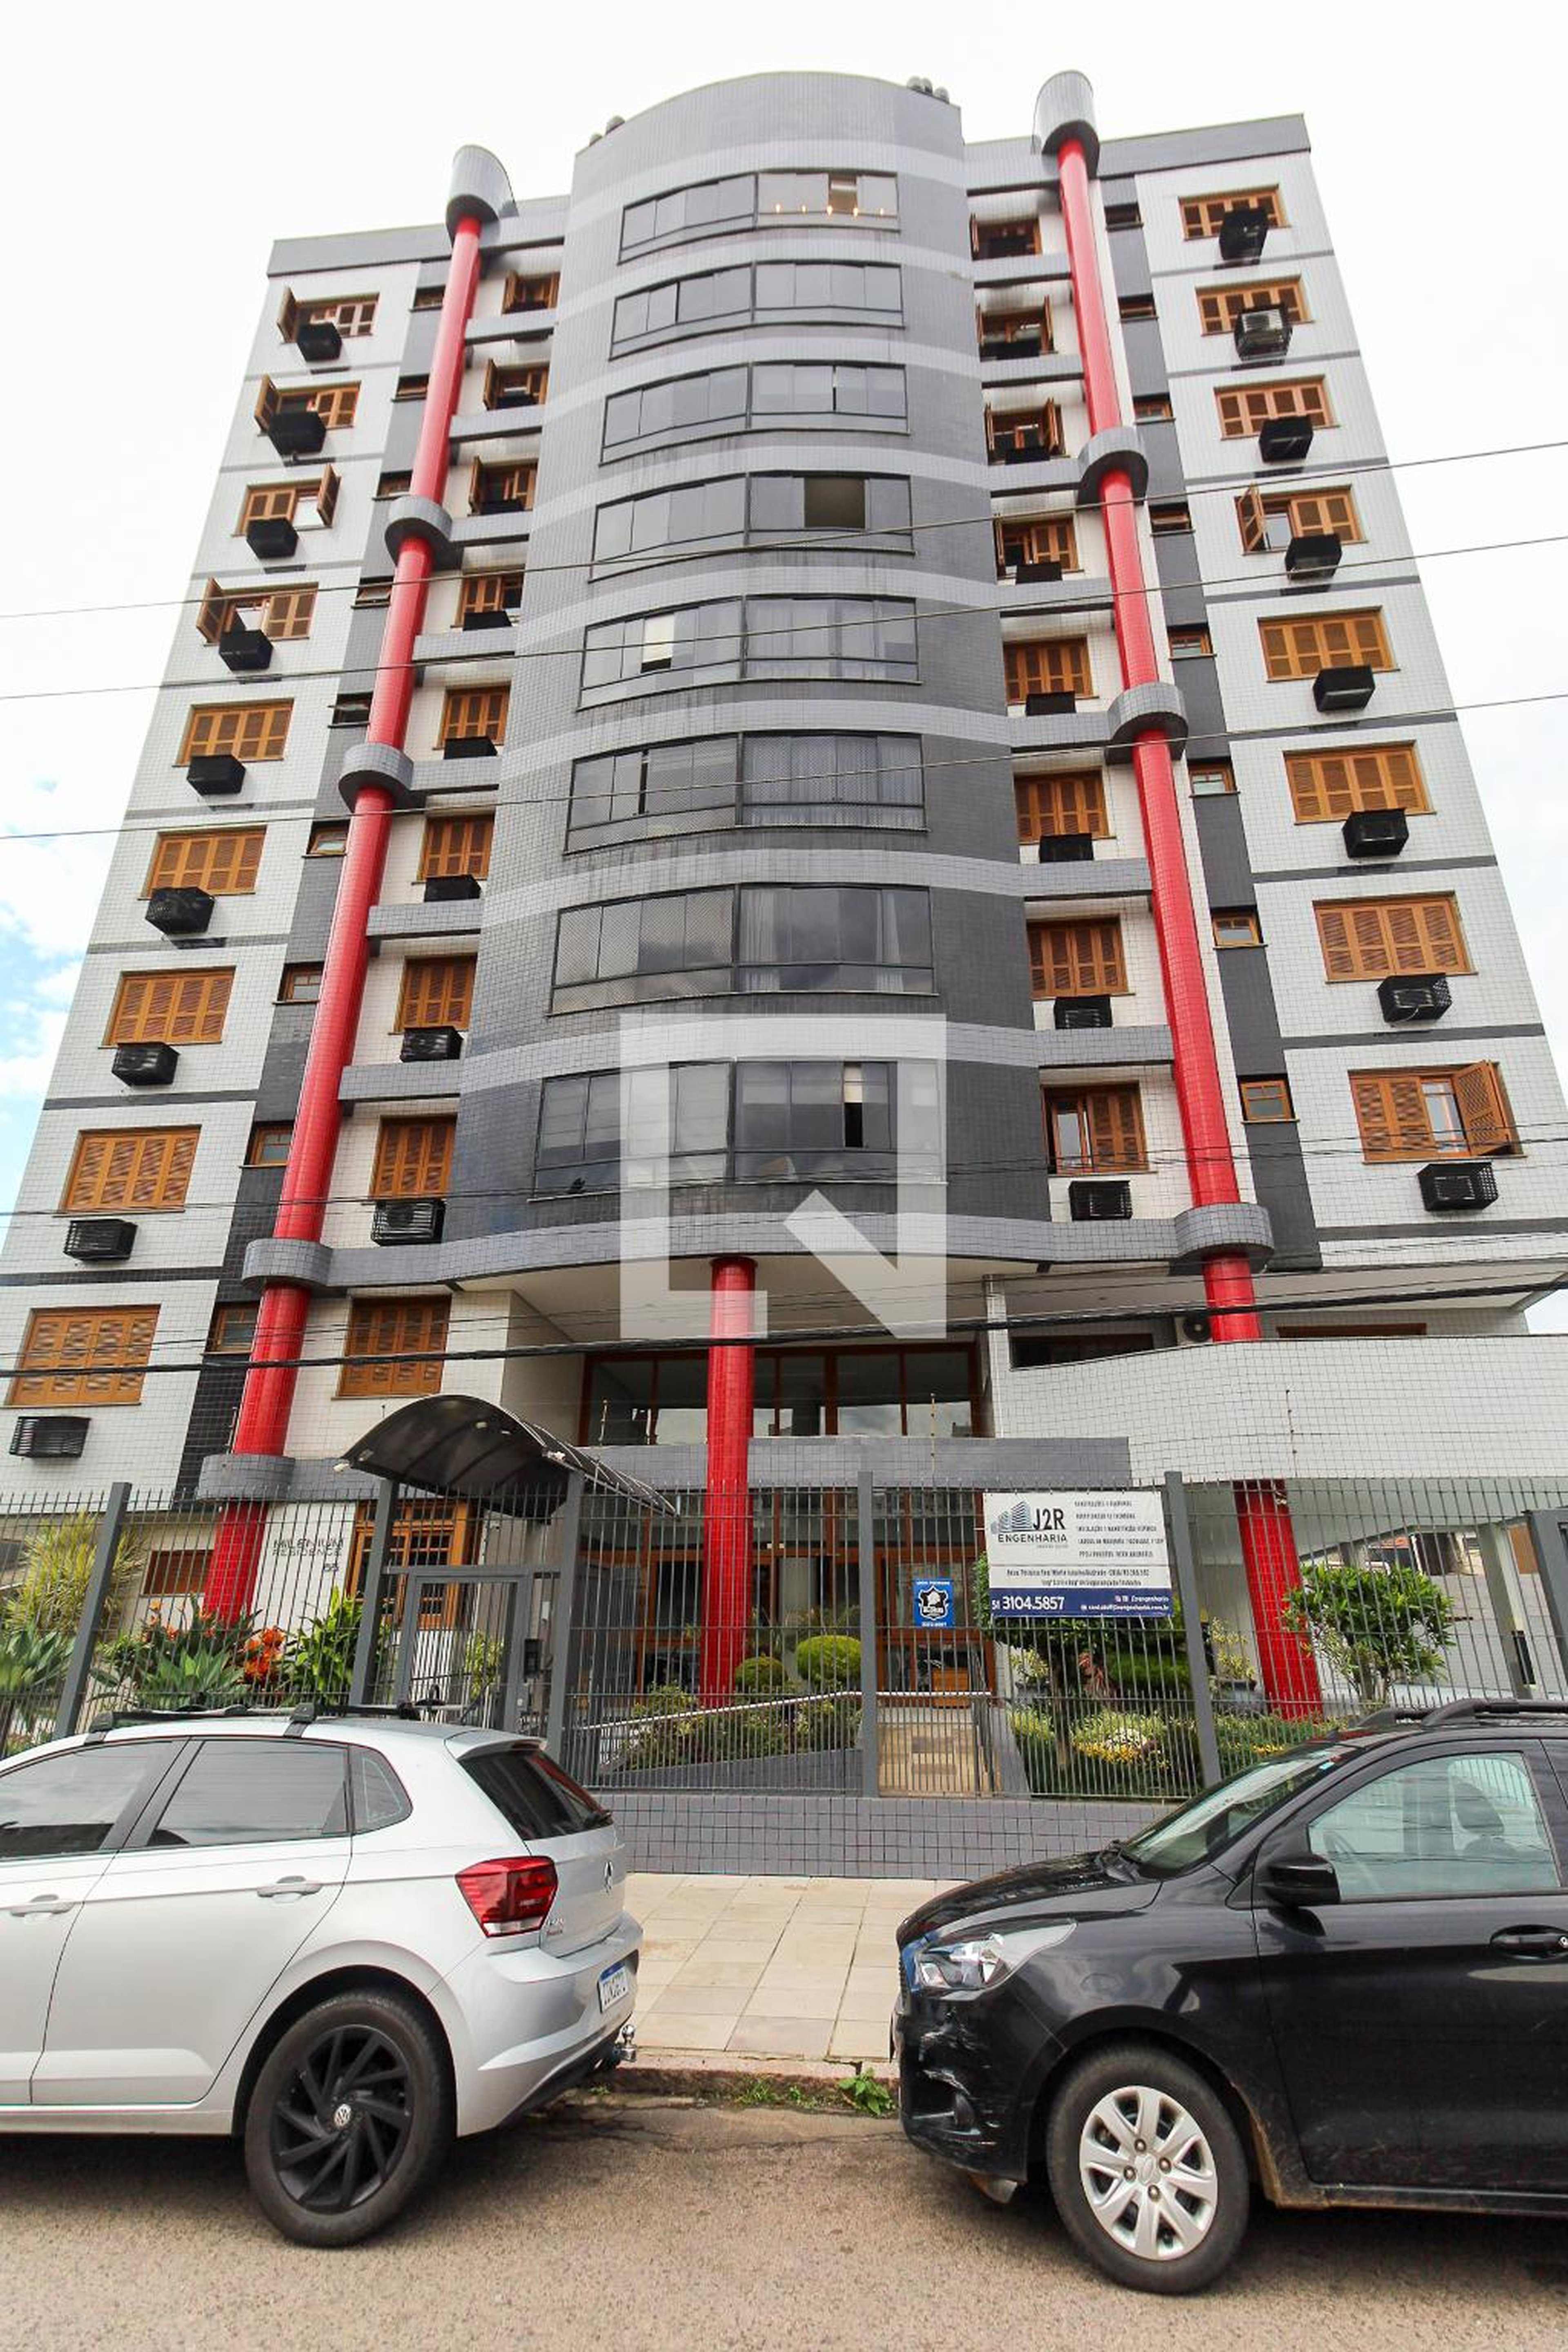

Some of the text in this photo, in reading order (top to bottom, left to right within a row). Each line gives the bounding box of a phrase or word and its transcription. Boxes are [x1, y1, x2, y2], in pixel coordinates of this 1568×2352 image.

[1033, 1508, 1066, 1530] J2R
[998, 1533, 1068, 1543] ENGENHARIA
[992, 1596, 1065, 1610] 51 3104.5857
